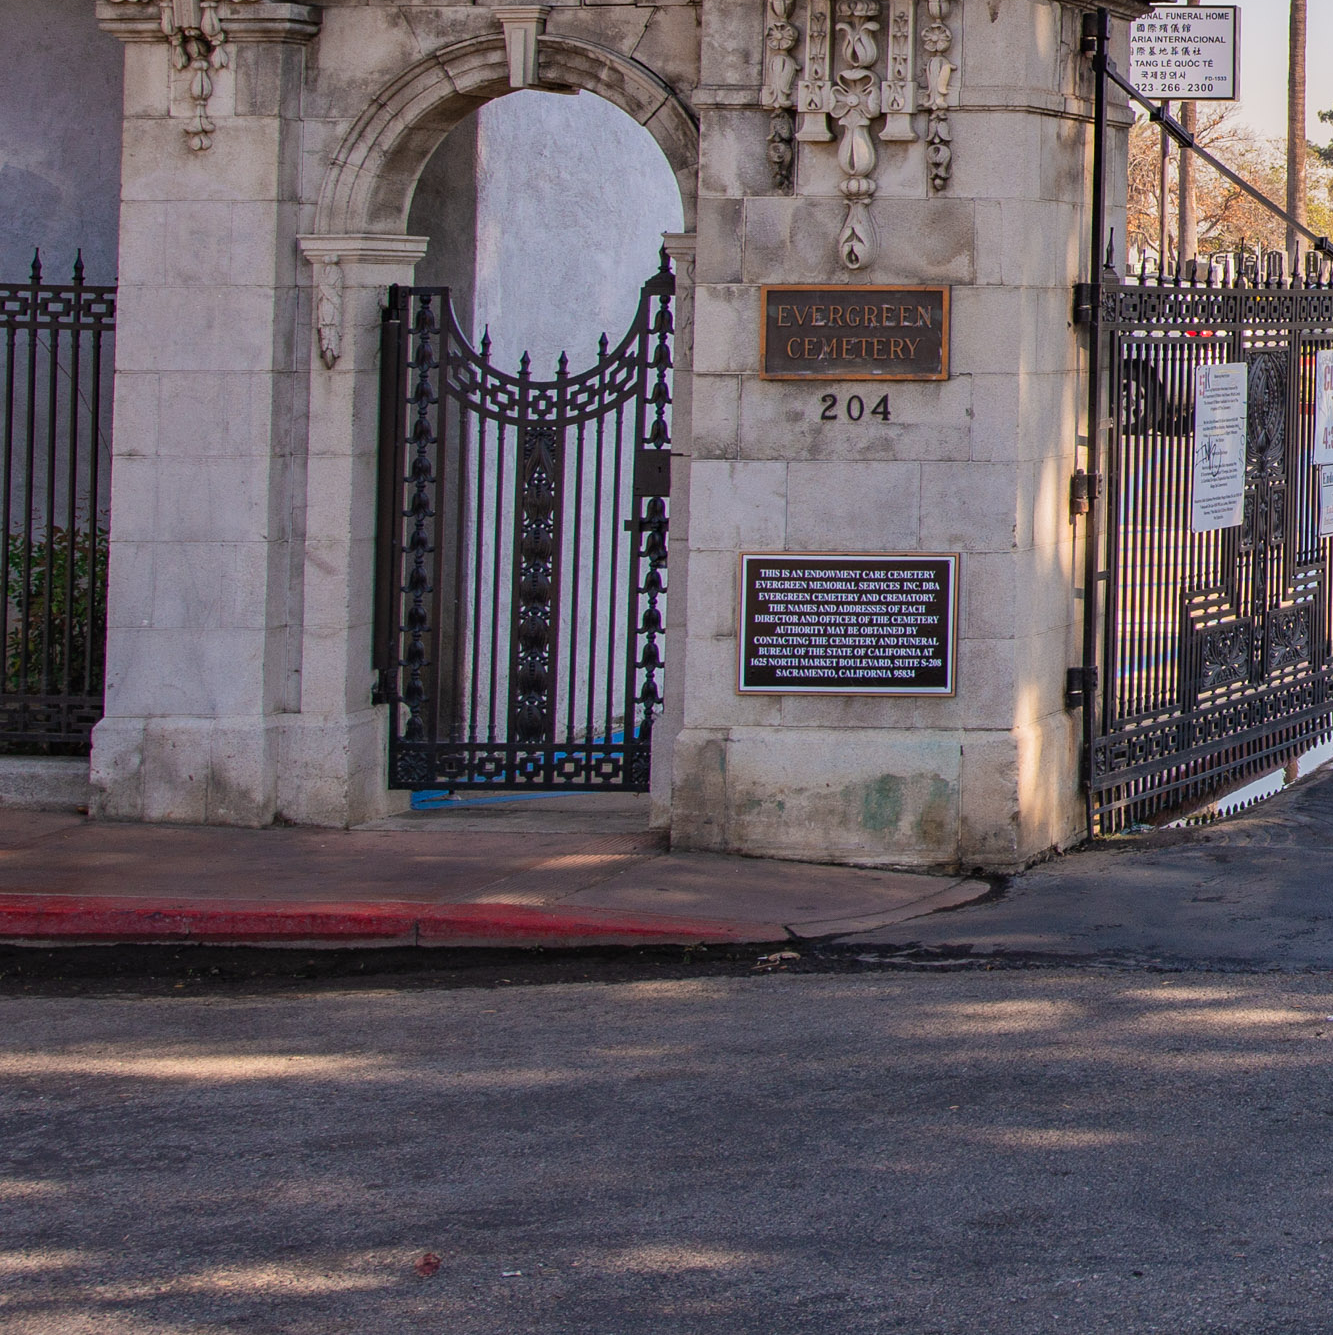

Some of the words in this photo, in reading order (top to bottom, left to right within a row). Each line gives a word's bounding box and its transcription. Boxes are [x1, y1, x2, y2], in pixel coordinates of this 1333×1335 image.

[1138, 12, 1163, 20] ONAL
[1166, 12, 1204, 20] FUNERAL
[1205, 12, 1230, 20] HOME
[1131, 35, 1153, 44] ARIA
[1154, 35, 1226, 44] INTERNACIONAL
[1135, 60, 1159, 68] TANG
[777, 305, 932, 328] EVERGREEN
[787, 337, 922, 359] CEMETERY
[820, 393, 891, 421] 204
[760, 569, 780, 578] THIS
[782, 570, 790, 578] IS
[791, 570, 803, 578] AN
[805, 570, 861, 578] ENDOWMENT
[862, 570, 886, 579] CARE
[888, 571, 936, 579] CEMETERY
[755, 581, 807, 589] EVERGREEN
[809, 581, 857, 589] MEMORIAL
[858, 582, 900, 590] SERVICES
[922, 582, 940, 590] DBA
[759, 593, 810, 601] EVERGREEN
[812, 593, 860, 601] CEMETERY
[861, 593, 879, 601] AND
[881, 594, 937, 602] CREMATORY.
[768, 604, 786, 612] THE
[788, 604, 817, 613] NAMES
[818, 604, 836, 613] AND
[837, 605, 886, 613] ADDRESSES
[888, 605, 900, 613] OF
[902, 605, 926, 613] EACH
[755, 615, 799, 623] DIRECTOR
[800, 615, 818, 623] AND
[820, 615, 857, 623] OFFICER
[858, 615, 871, 623] OF
[891, 616, 939, 624] CEMETERY
[775, 626, 825, 634] AUTHORITY
[826, 626, 846, 634] MAY
[848, 626, 860, 634] BE
[861, 626, 905, 634] OBTAINED
[906, 627, 918, 635] BY
[754, 636, 809, 645] CONTACTING
[810, 637, 828, 645] THE
[830, 637, 878, 645] CEMETERY
[878, 637, 897, 645] AND
[759, 647, 793, 655] BUREAU
[794, 647, 807, 656] OF
[808, 648, 826, 656] THE
[826, 648, 853, 656] STATE
[854, 648, 866, 656] OF
[868, 648, 921, 656] CALIFORNIA
[922, 648, 934, 656] AT
[750, 658, 767, 666] 1625
[768, 658, 798, 666] NORTH
[800, 658, 838, 666] MARKET
[839, 659, 893, 668] BOULEVARD,
[894, 659, 920, 667] SUITE
[921, 659, 942, 667] S-208
[776, 669, 838, 679] SACRAMENTO,
[839, 670, 892, 678] CALIFORNIA
[894, 670, 915, 678] 95834
